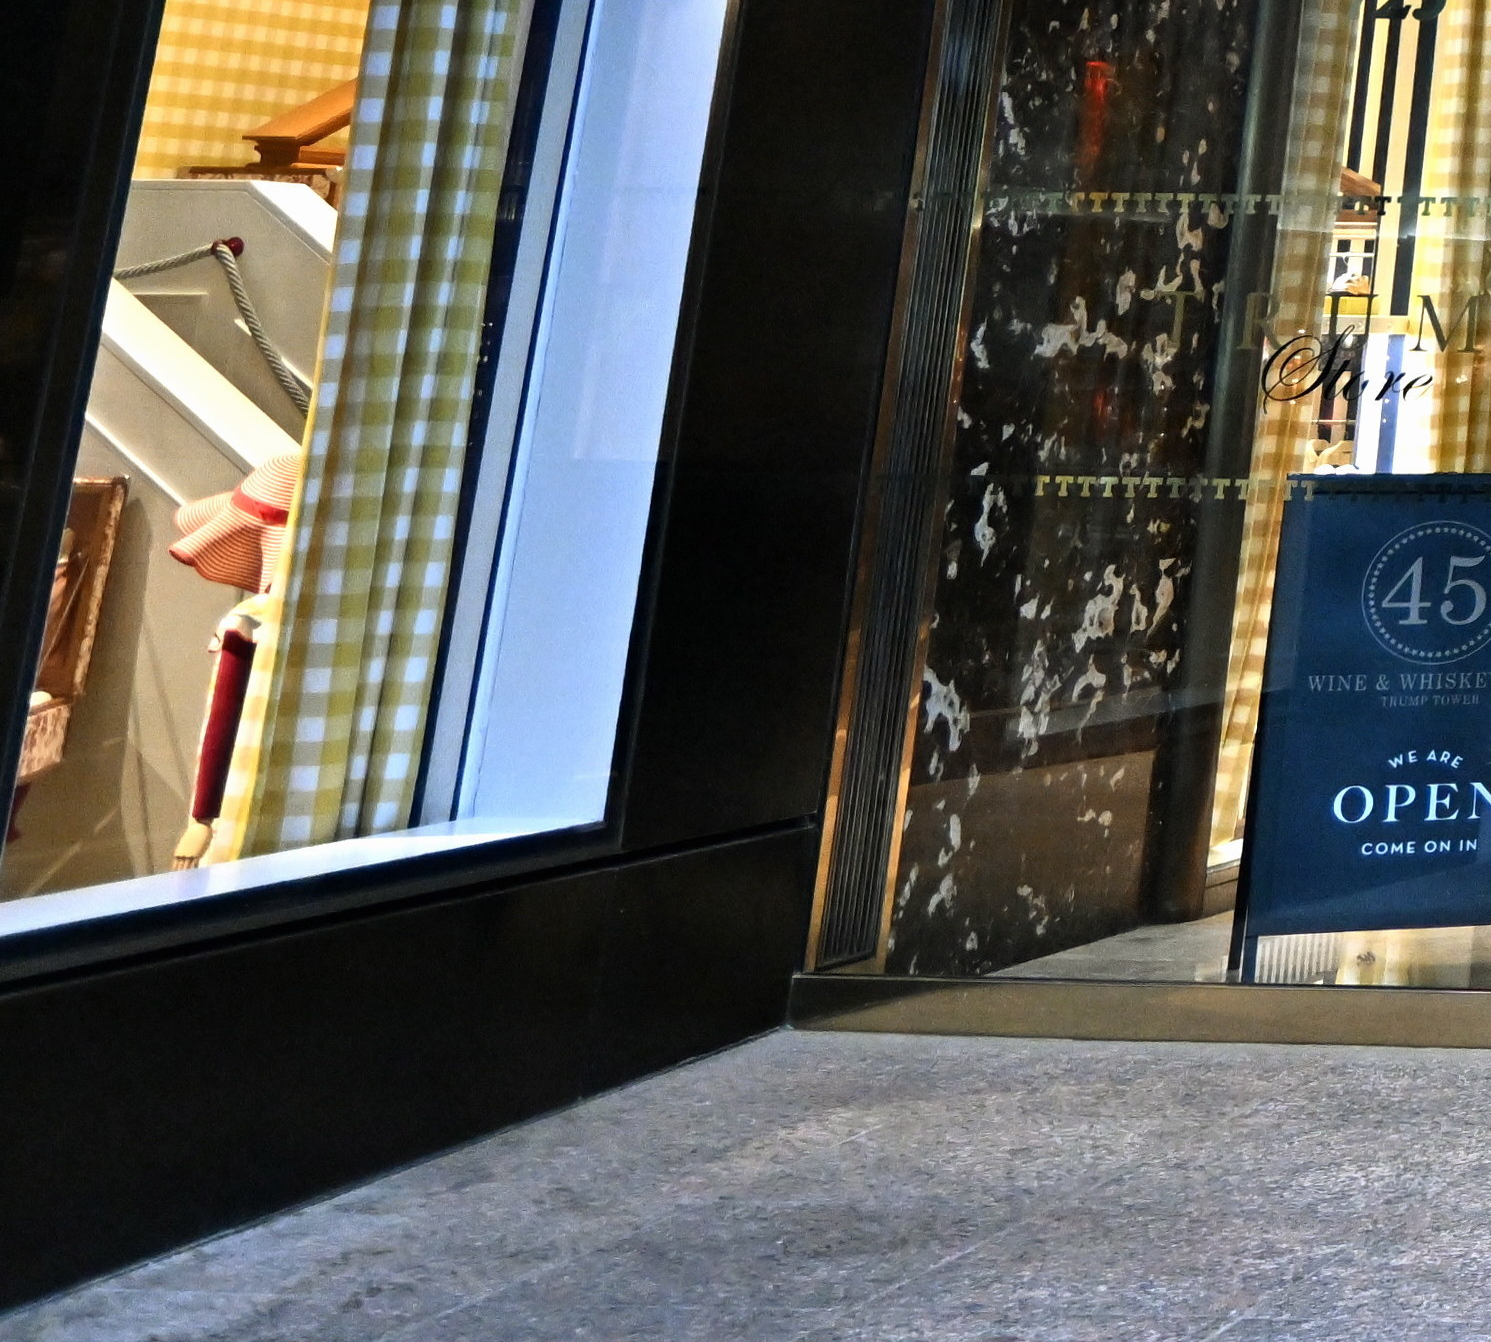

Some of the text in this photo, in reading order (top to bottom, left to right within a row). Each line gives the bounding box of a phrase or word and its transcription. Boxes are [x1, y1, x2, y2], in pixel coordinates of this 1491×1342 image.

[1261, 324, 1434, 415] Store
[1381, 554, 1488, 626] 45
[1308, 674, 1368, 692] WINE
[1375, 674, 1391, 691] &
[1433, 694, 1480, 706] TOWER
[1388, 749, 1464, 770] WE ARE
[1361, 838, 1479, 857] COME ON IN
